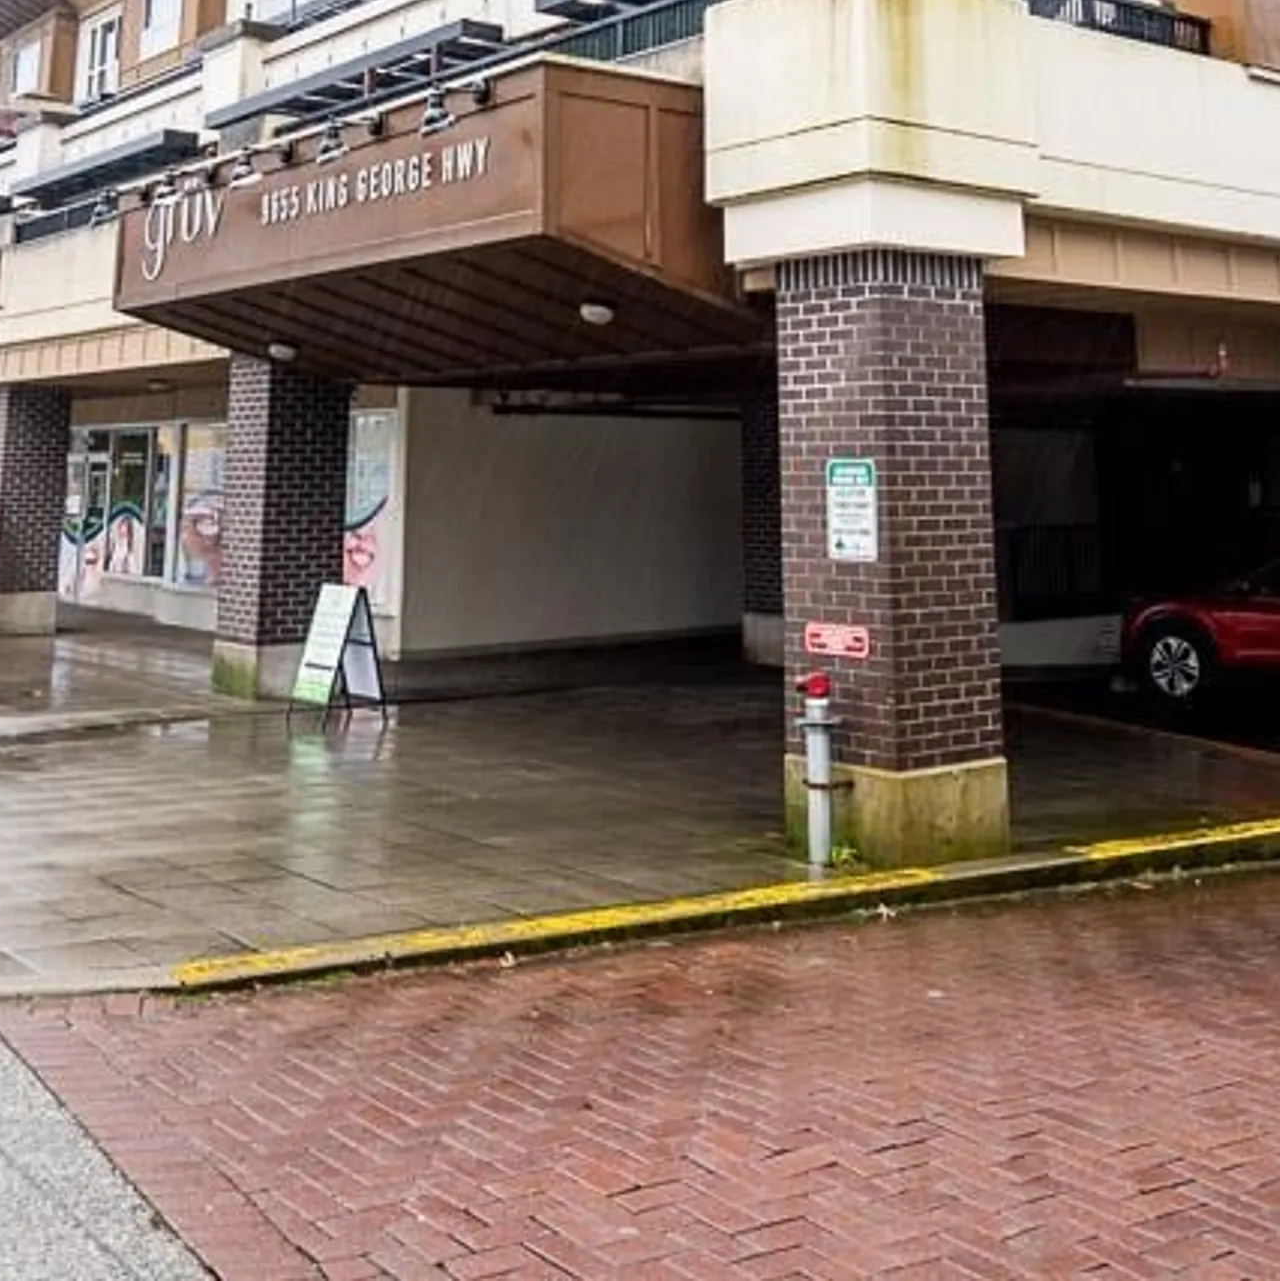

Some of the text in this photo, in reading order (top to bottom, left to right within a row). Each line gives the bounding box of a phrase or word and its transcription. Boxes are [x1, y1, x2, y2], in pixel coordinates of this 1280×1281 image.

[307, 173, 349, 213] KING
[356, 152, 433, 203] GEORGE
[442, 136, 490, 183] HWY
